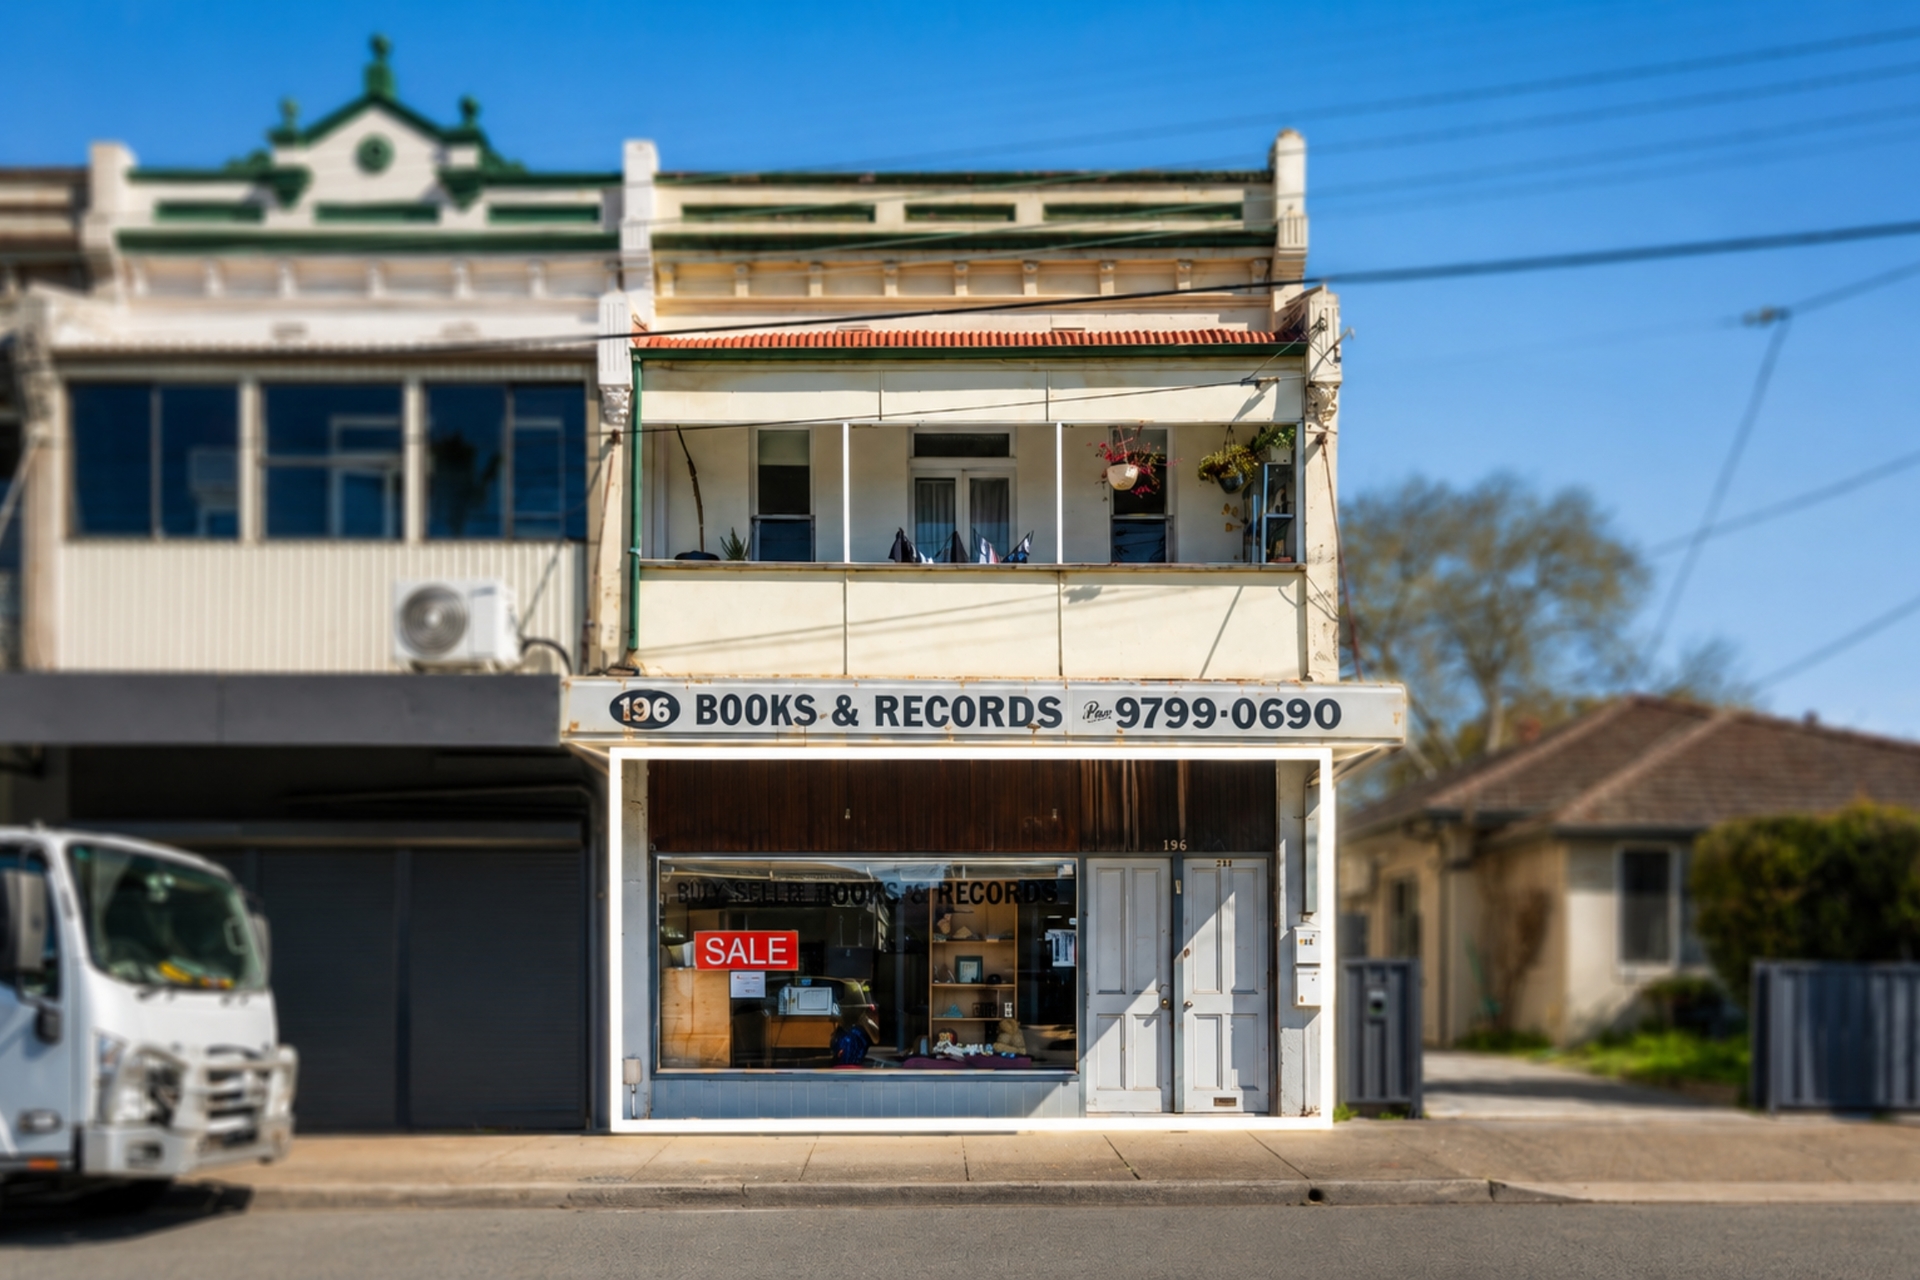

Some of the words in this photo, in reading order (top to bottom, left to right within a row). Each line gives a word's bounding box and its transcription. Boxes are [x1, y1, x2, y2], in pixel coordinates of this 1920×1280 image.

[619, 696, 671, 723] 196
[695, 693, 818, 726] BOOKS
[831, 694, 859, 727] &
[874, 694, 1063, 729] RECORDS
[1163, 838, 1188, 851] 196
[938, 880, 1059, 905] RECORDS
[705, 936, 788, 966] SALE
